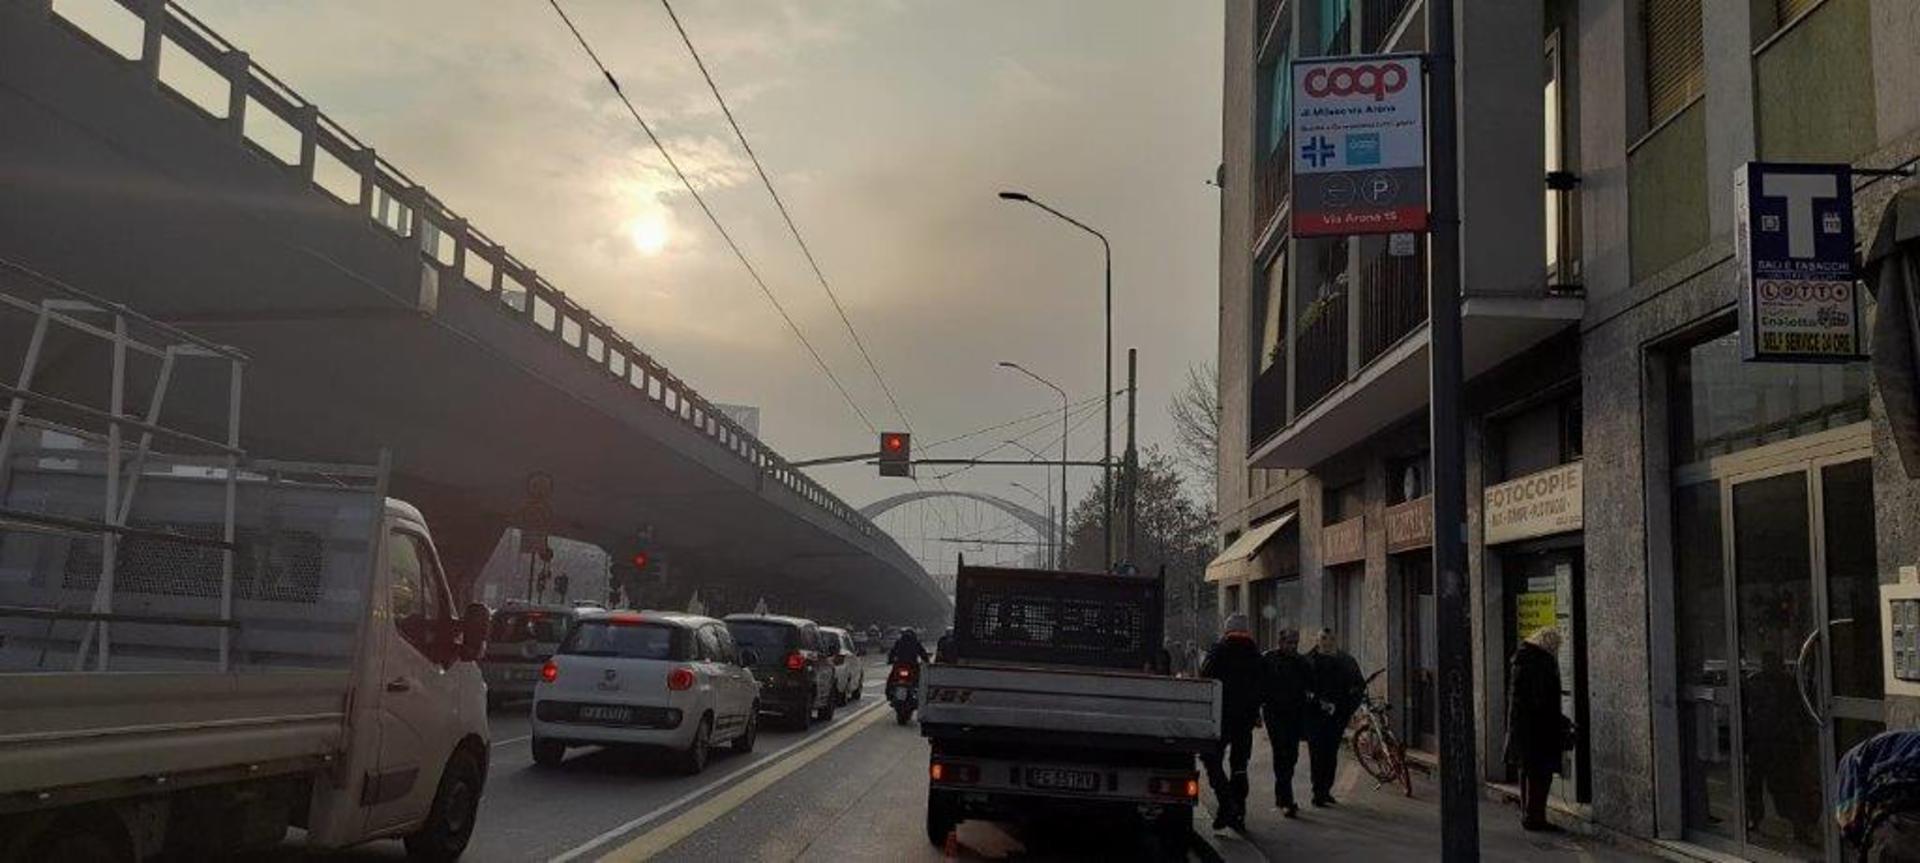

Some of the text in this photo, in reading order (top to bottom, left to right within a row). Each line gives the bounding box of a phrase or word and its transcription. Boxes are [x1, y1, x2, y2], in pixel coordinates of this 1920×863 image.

[1304, 62, 1408, 101] coop
[1366, 105, 1396, 114] Arona
[1373, 180, 1389, 201] P
[1322, 214, 1342, 224] Via
[1345, 212, 1382, 223] Arona
[1762, 173, 1838, 259] T
[1761, 281, 1849, 302] LOTTO
[1785, 332, 1821, 351] SERVICE
[1486, 468, 1578, 509] FOTOCOPIE
